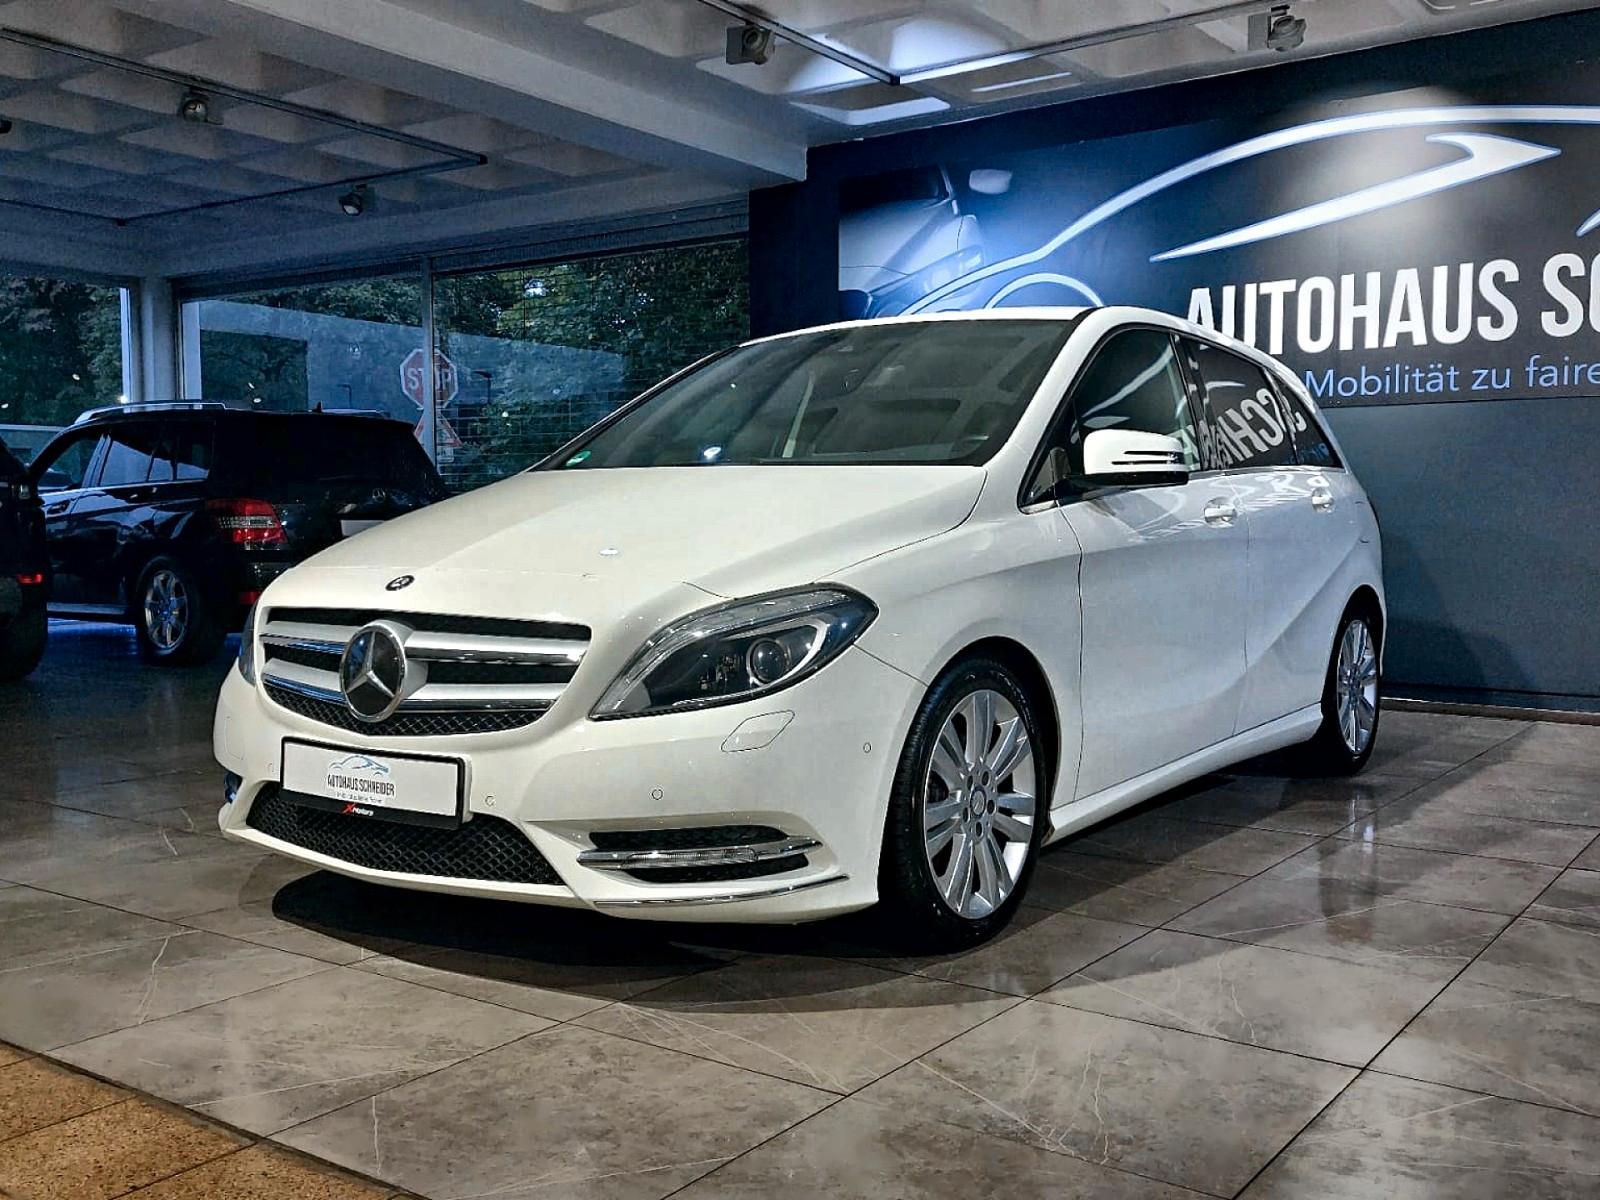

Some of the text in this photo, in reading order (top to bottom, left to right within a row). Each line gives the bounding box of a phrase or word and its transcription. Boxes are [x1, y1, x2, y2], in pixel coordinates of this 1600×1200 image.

[1187, 258, 1520, 356] AUTOHAUS
[407, 366, 452, 390] SOP
[1304, 354, 1600, 398] Mobilität zu faire
[328, 774, 394, 795] AUTOHAUS SCHNEIDER
